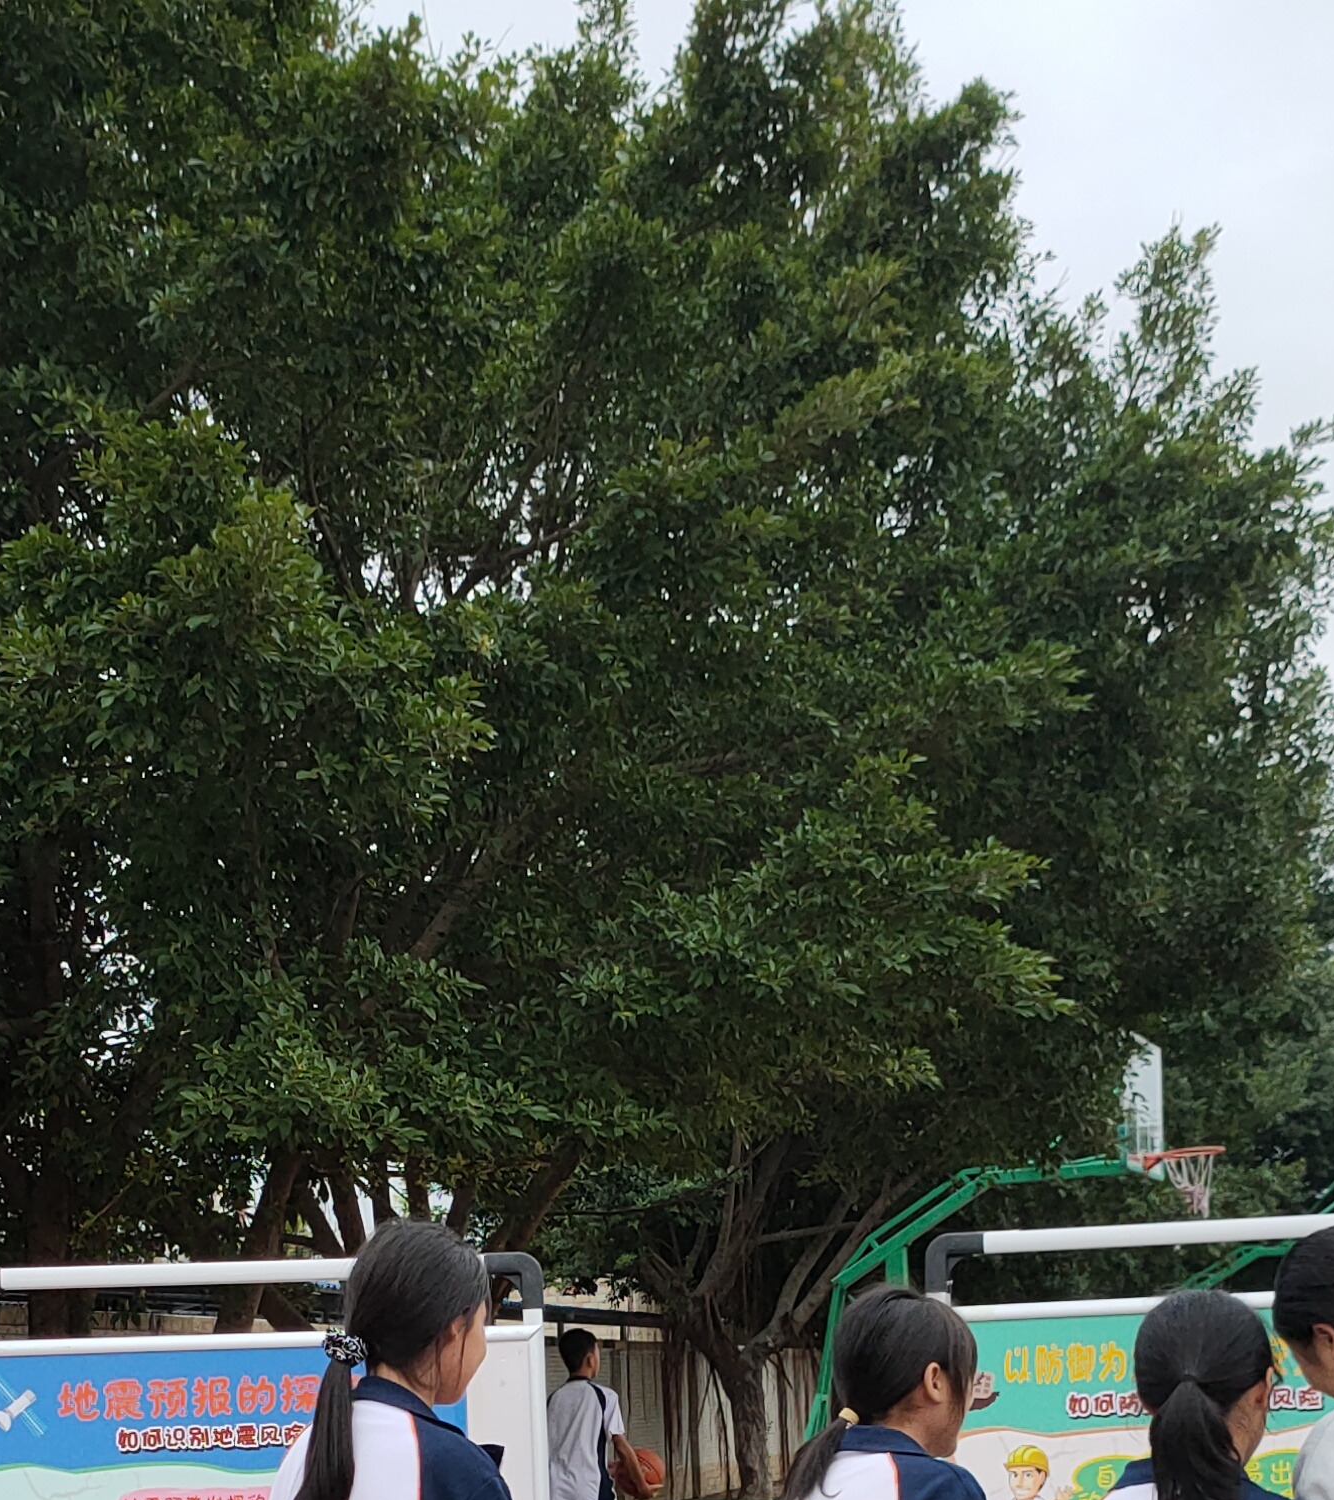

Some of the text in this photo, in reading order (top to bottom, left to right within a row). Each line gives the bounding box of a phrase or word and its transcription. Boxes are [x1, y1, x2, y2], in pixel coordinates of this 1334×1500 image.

[1004, 1340, 1136, 1384] 以防御为
[58, 1374, 364, 1421] 地震预报的探
[1066, 1389, 1155, 1418] 如何防
